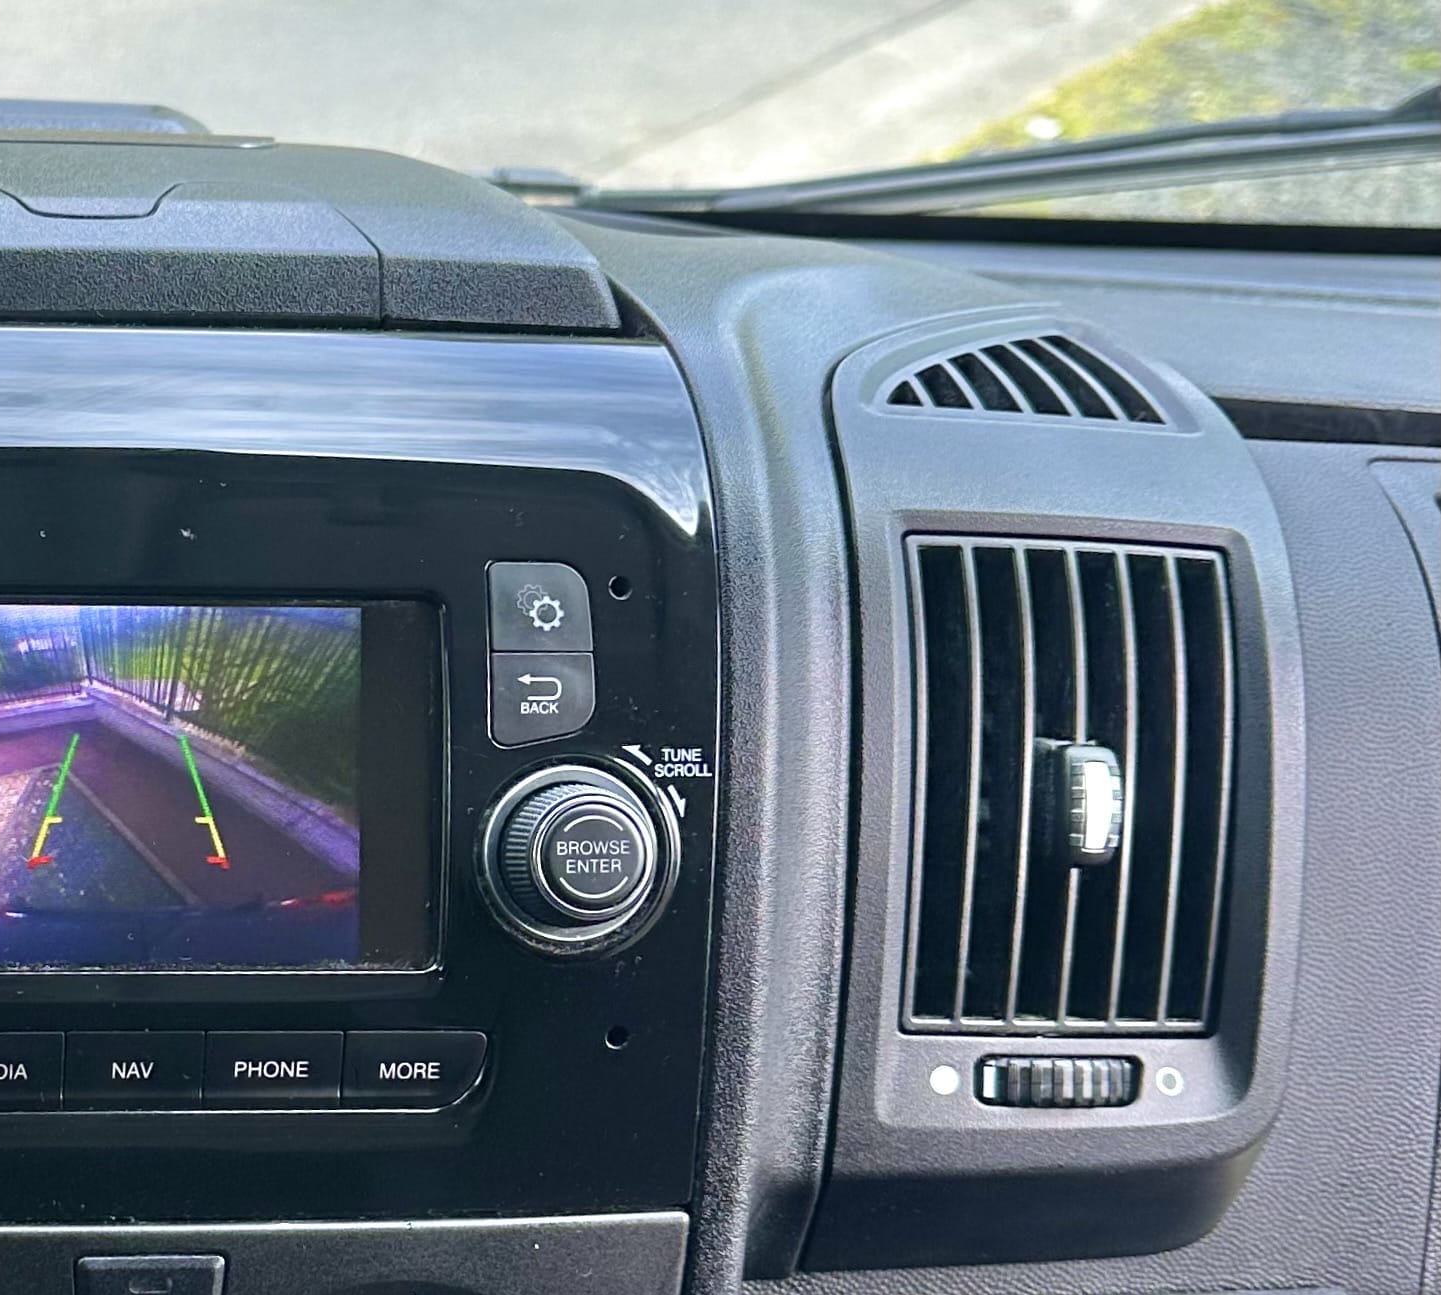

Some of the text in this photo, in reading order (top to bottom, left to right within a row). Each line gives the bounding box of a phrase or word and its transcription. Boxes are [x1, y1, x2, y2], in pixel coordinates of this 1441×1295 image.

[520, 701, 559, 715] BACK
[661, 748, 703, 762] TUNE
[654, 763, 713, 778] SCROLL
[556, 840, 630, 856] BROWSE
[566, 859, 622, 874] ENTER
[111, 1062, 154, 1079] NAV
[234, 1061, 309, 1078] PHONE
[379, 1062, 441, 1080] MORE
